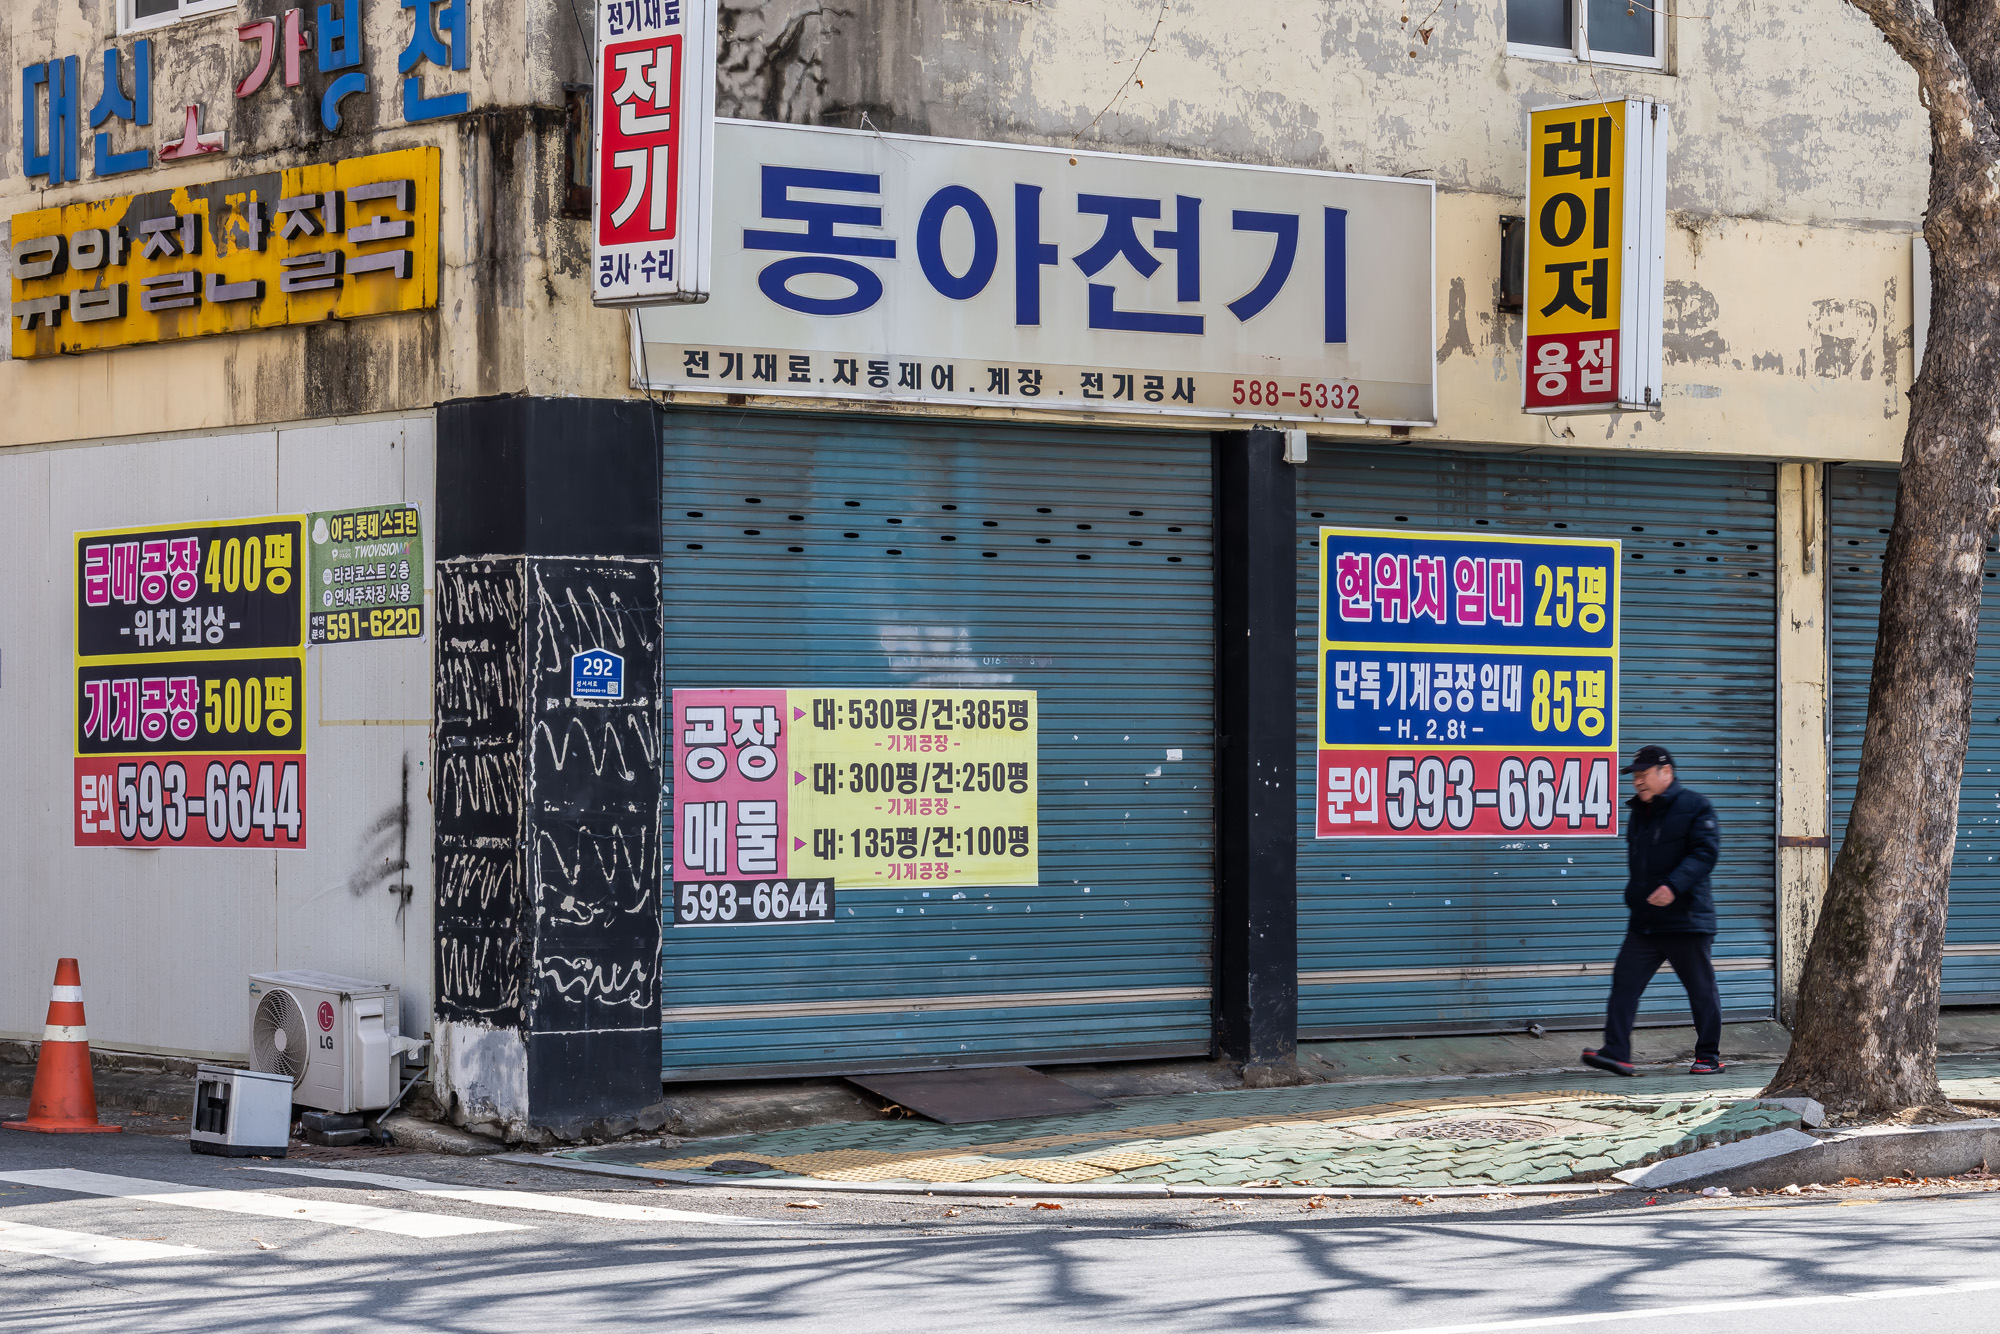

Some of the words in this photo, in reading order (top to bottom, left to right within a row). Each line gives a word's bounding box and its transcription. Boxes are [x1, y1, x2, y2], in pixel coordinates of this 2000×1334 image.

[607, 0, 680, 36] 전기재료
[610, 44, 674, 232] 전기
[1538, 116, 1613, 320] 레이저
[743, 163, 1349, 345] 동아전기
[1080, 371, 1196, 404] 전기공사
[1232, 379, 1361, 410] 588-5332
[1533, 337, 1613, 397] 용접
[85, 536, 201, 607] 급매공장
[204, 532, 293, 595] 400평
[333, 563, 387, 584] 라라코스트
[334, 584, 387, 607] 연세주차장
[389, 583, 411, 603] 사용
[1336, 552, 1447, 625] 현위치
[1453, 556, 1524, 627] 임대
[1534, 564, 1607, 634] 25평
[326, 607, 420, 641] 591-6220
[583, 657, 613, 676] 292
[84, 675, 200, 742] 기계공장
[204, 675, 293, 737] 500평
[1531, 669, 1606, 737] 85평
[683, 704, 781, 783] 공장
[80, 774, 116, 834] 문의
[117, 759, 302, 842] 593-6644
[1327, 766, 1379, 825] 문의
[1385, 755, 1612, 832] 593-6644
[683, 799, 779, 877] 매물
[680, 881, 829, 922] 593-6644
[319, 1035, 334, 1050] LG
